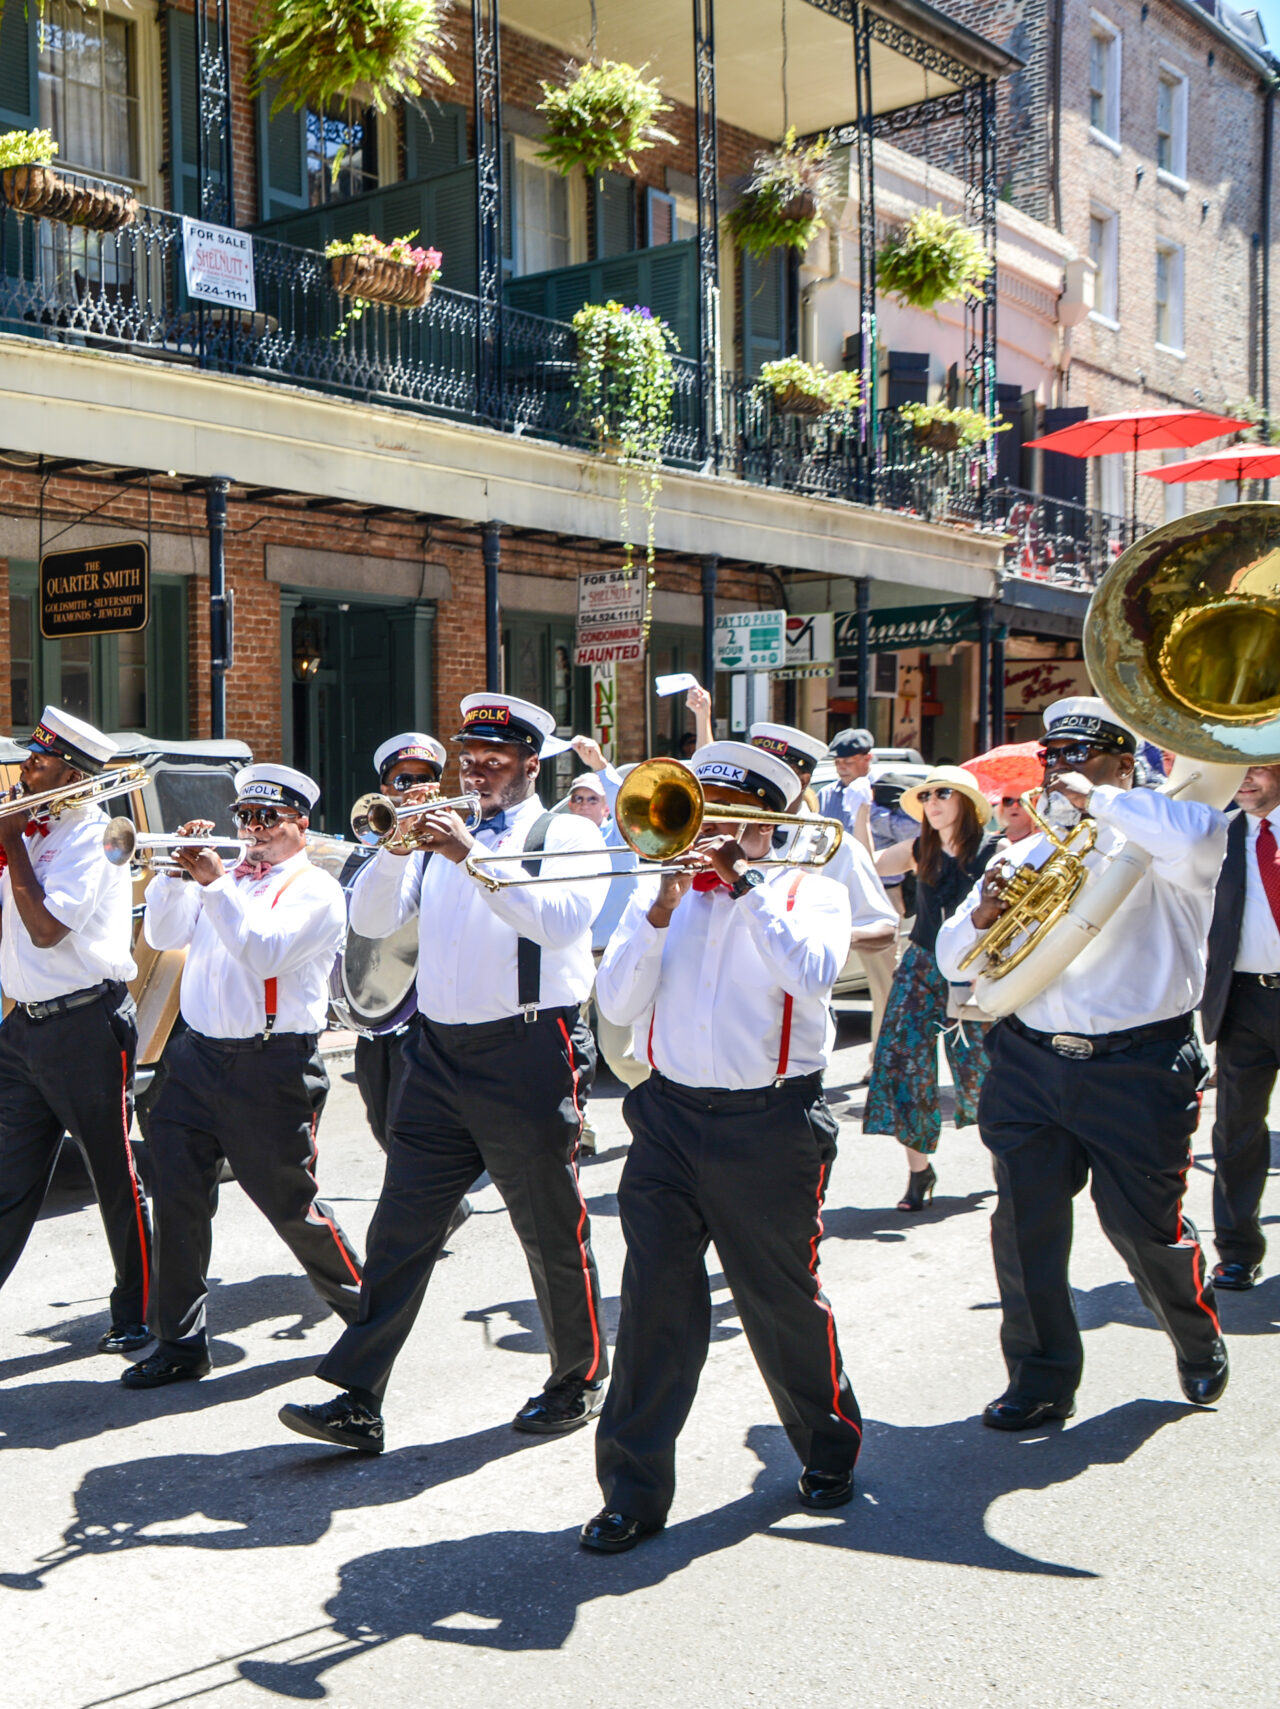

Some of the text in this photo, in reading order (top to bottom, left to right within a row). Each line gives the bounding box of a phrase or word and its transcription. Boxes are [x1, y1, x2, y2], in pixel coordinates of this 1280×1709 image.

[190, 227, 247, 249] FOR SALE
[196, 248, 243, 275] SHELNUTT
[196, 282, 247, 302] 524-1111
[85, 561, 101, 572] THE
[47, 568, 140, 597] QUARTER SMITH
[584, 575, 606, 586] FOR
[45, 594, 143, 613] GOLDSMITH SILVERSMITH
[53, 606, 133, 623] DIAMONDS JEWELRY
[716, 612, 781, 629] PAY TO PARK
[580, 628, 640, 644] CONDOMINIUM
[727, 629, 736, 645] 2
[577, 644, 640, 664] HAUNTED
[718, 645, 745, 656] HOUR
[772, 667, 832, 679] SMETICS
[696, 764, 742, 780] NFOLK
[243, 785, 278, 796] NFOLK
